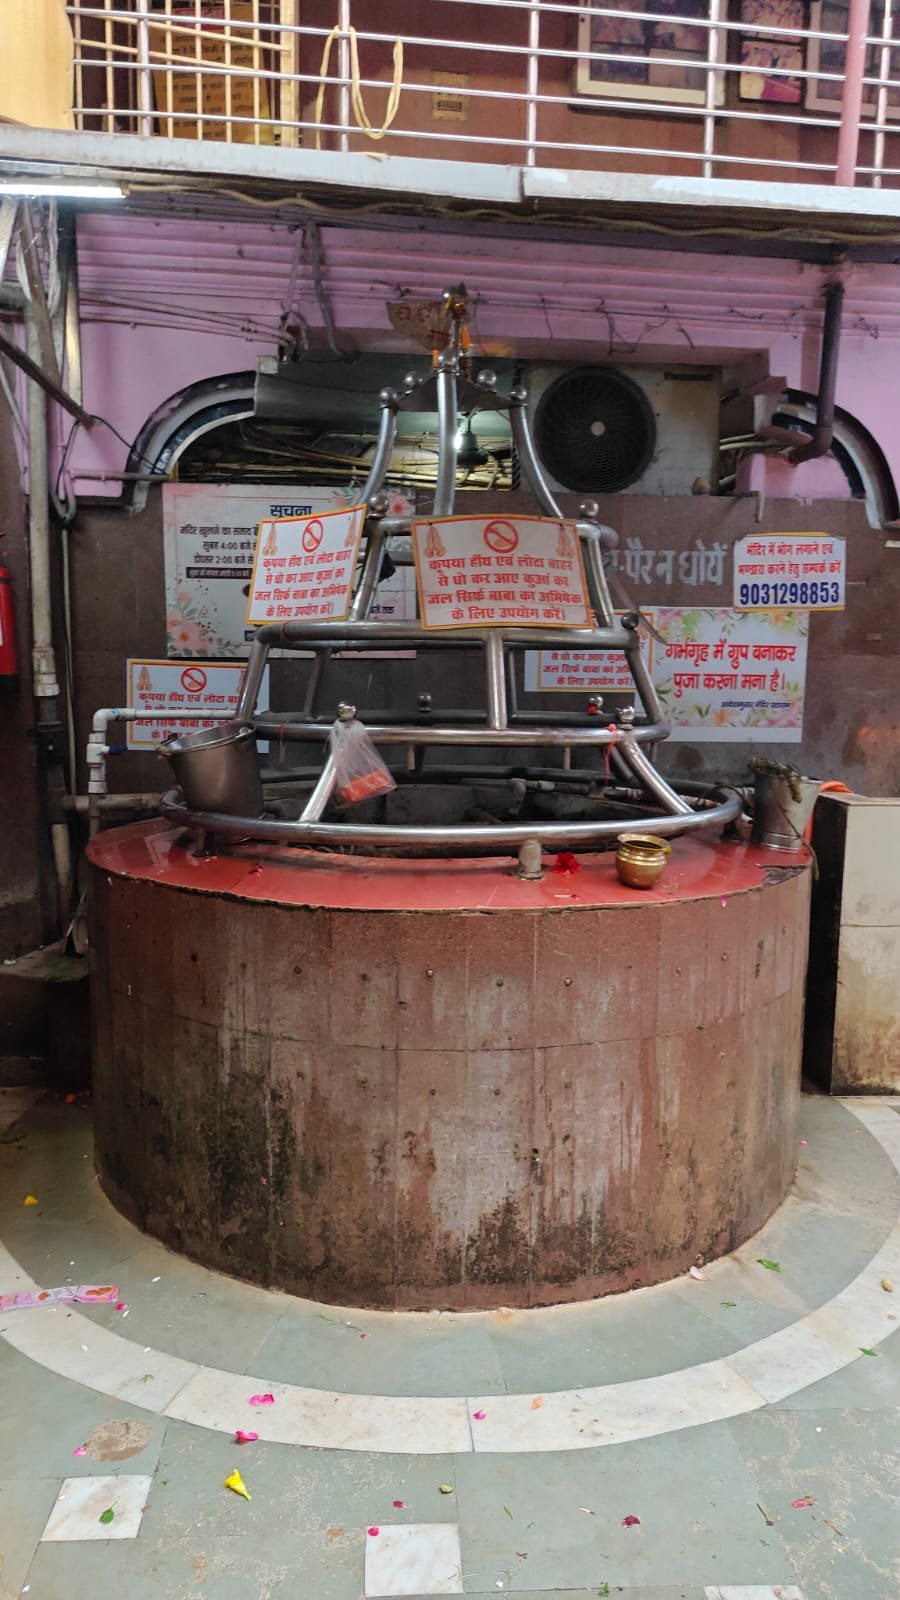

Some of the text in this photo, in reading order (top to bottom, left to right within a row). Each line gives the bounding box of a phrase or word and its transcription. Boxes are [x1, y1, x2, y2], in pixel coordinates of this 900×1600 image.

[221, 542, 238, 550] 4:00
[215, 555, 233, 564] 2:00
[428, 557, 465, 573] कृपया
[495, 554, 513, 567] एवं
[518, 555, 544, 568] लोटा
[548, 558, 573, 570] बाहर
[437, 575, 449, 587] से
[471, 574, 490, 584] कर
[493, 573, 519, 584] आए
[554, 576, 568, 587] का
[427, 588, 582, 604] जल सिर्फ बाबा का अभिषेक
[740, 582, 839, 605] 9031298853
[451, 607, 464, 620] के
[468, 606, 494, 619] लिए
[499, 607, 539, 619] उपयोग
[665, 637, 710, 667] गर्भगृह
[713, 638, 727, 659] में
[728, 644, 749, 669] ग्रुप
[703, 674, 738, 689] करना
[741, 674, 766, 690] मना
